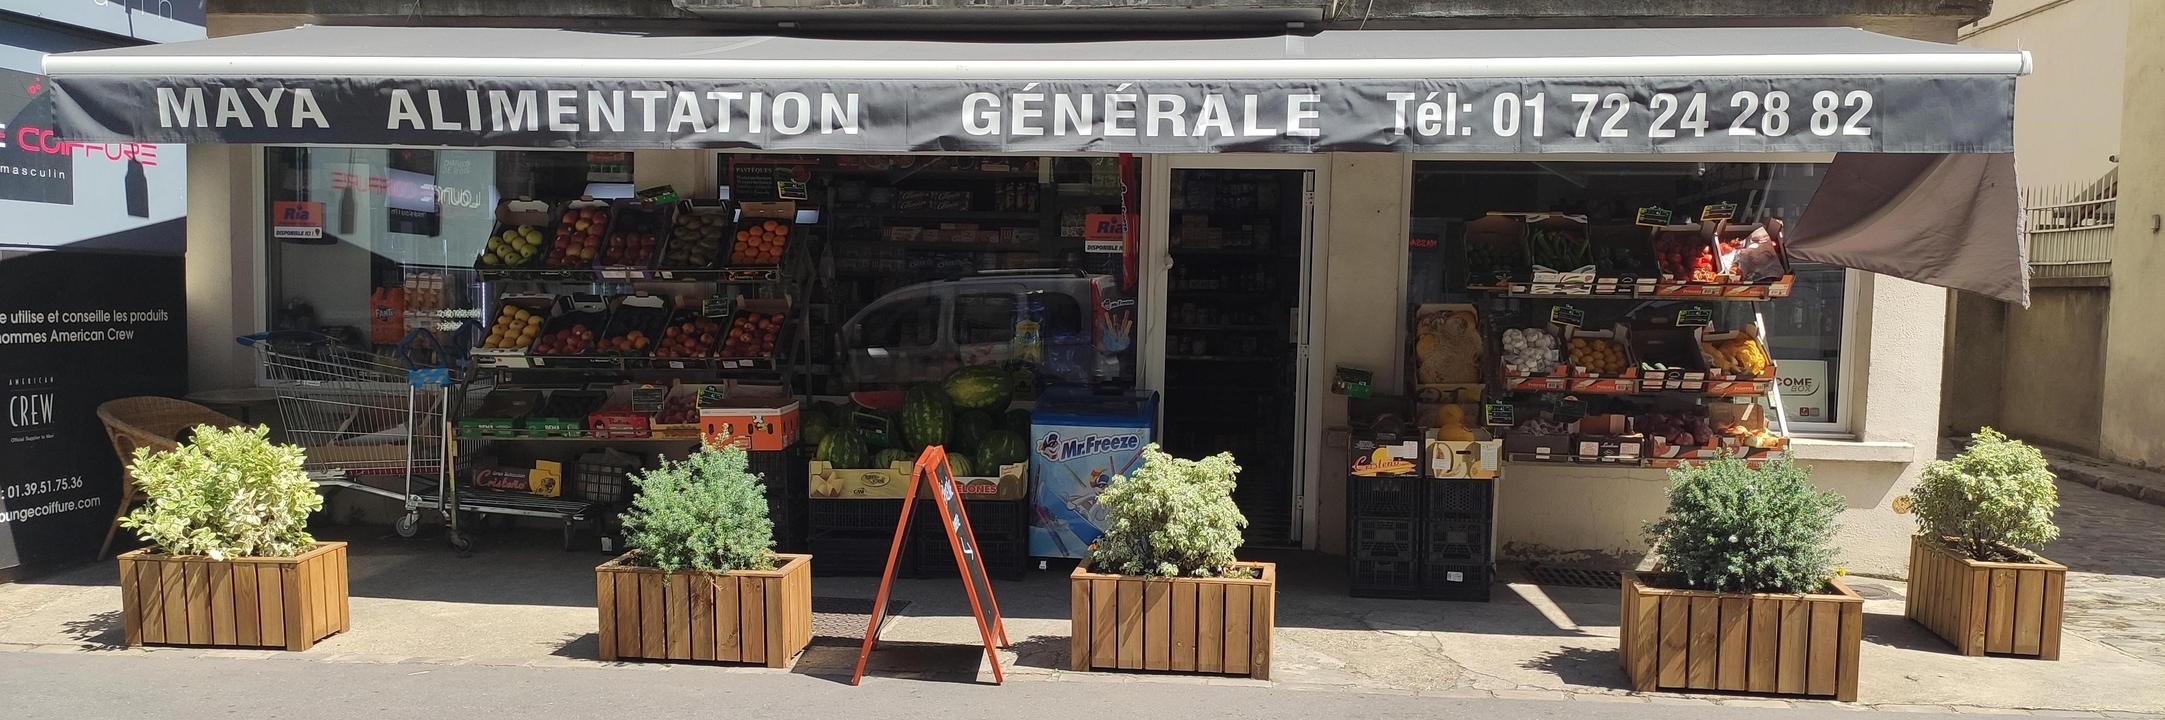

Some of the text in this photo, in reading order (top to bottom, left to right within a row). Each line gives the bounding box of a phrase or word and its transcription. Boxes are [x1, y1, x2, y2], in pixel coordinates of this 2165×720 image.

[156, 81, 1873, 138] MAYA ALIMENTATION GÉNÉRALE Tél: 01 72 24 28 82
[0, 165, 65, 179] masculin
[284, 204, 309, 220] Ria
[1097, 216, 1123, 233] Ria
[10, 310, 44, 324] utilise
[47, 310, 59, 323] et
[62, 309, 110, 323] conseille
[113, 309, 128, 322] les
[129, 309, 169, 324] produits
[50, 329, 105, 343] American
[107, 327, 134, 341] Crew
[9, 376, 54, 386] AMERICAN
[9, 393, 54, 427] CREW
[7, 475, 83, 499] 01.39.51.75.36
